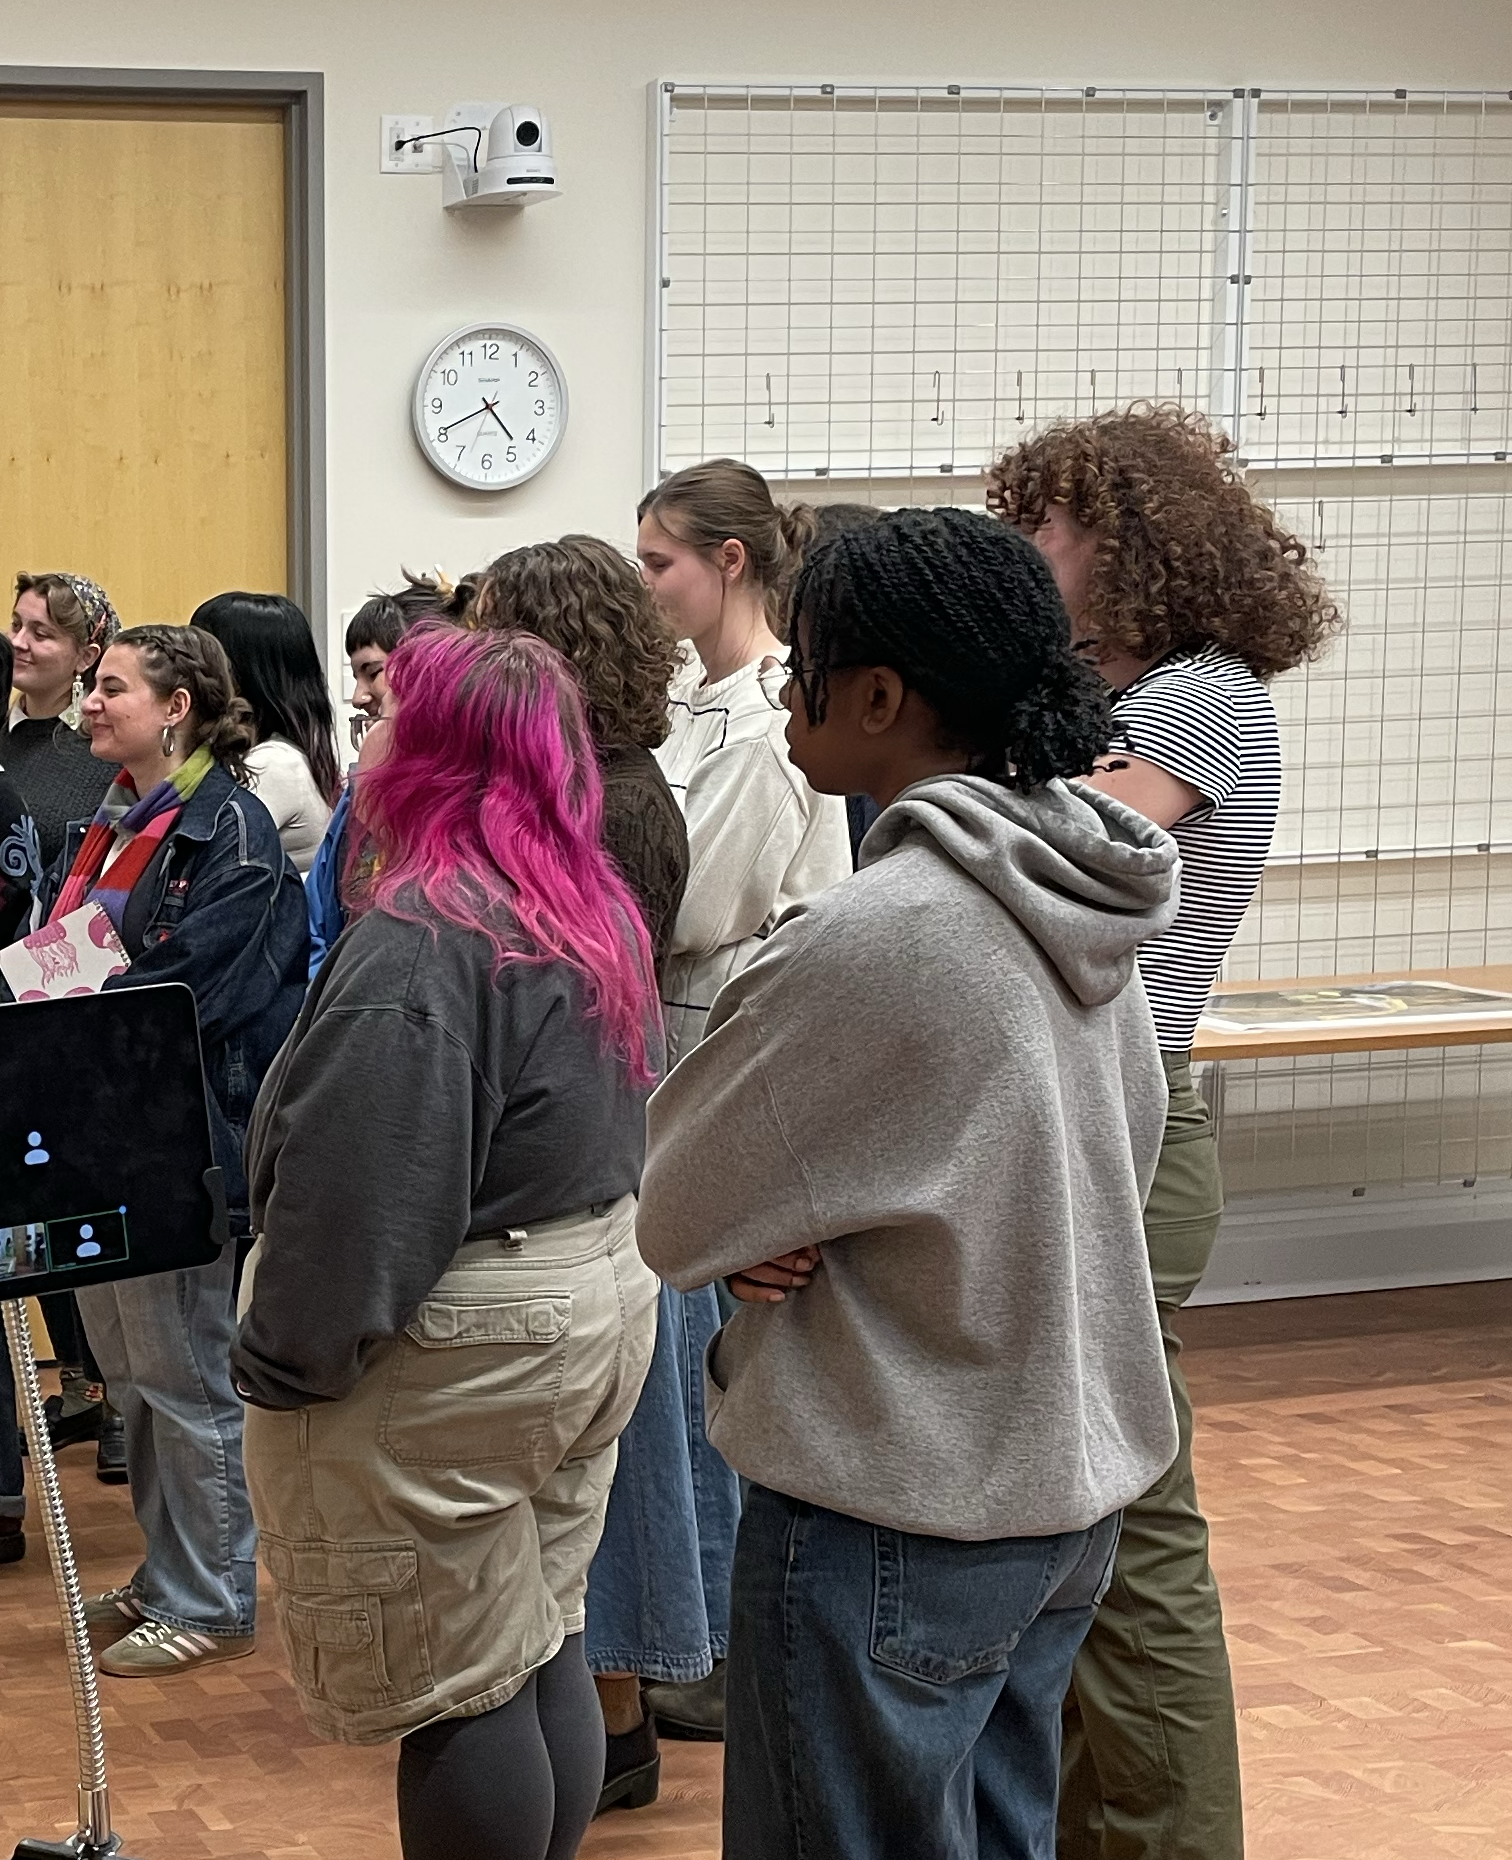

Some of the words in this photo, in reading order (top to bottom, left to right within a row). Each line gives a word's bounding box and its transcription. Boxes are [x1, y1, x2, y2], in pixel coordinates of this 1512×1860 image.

[458, 350, 473, 367] 11
[480, 342, 499, 361] 12
[511, 351, 518, 368] 1
[440, 368, 457, 386] 10
[527, 370, 538, 388] 2
[431, 397, 442, 415] 9
[533, 399, 544, 417] 3
[437, 426, 448, 443] 8
[525, 427, 536, 444] 4
[455, 445, 465, 462] 7
[481, 453, 492, 470] 6
[505, 445, 516, 463] 5
